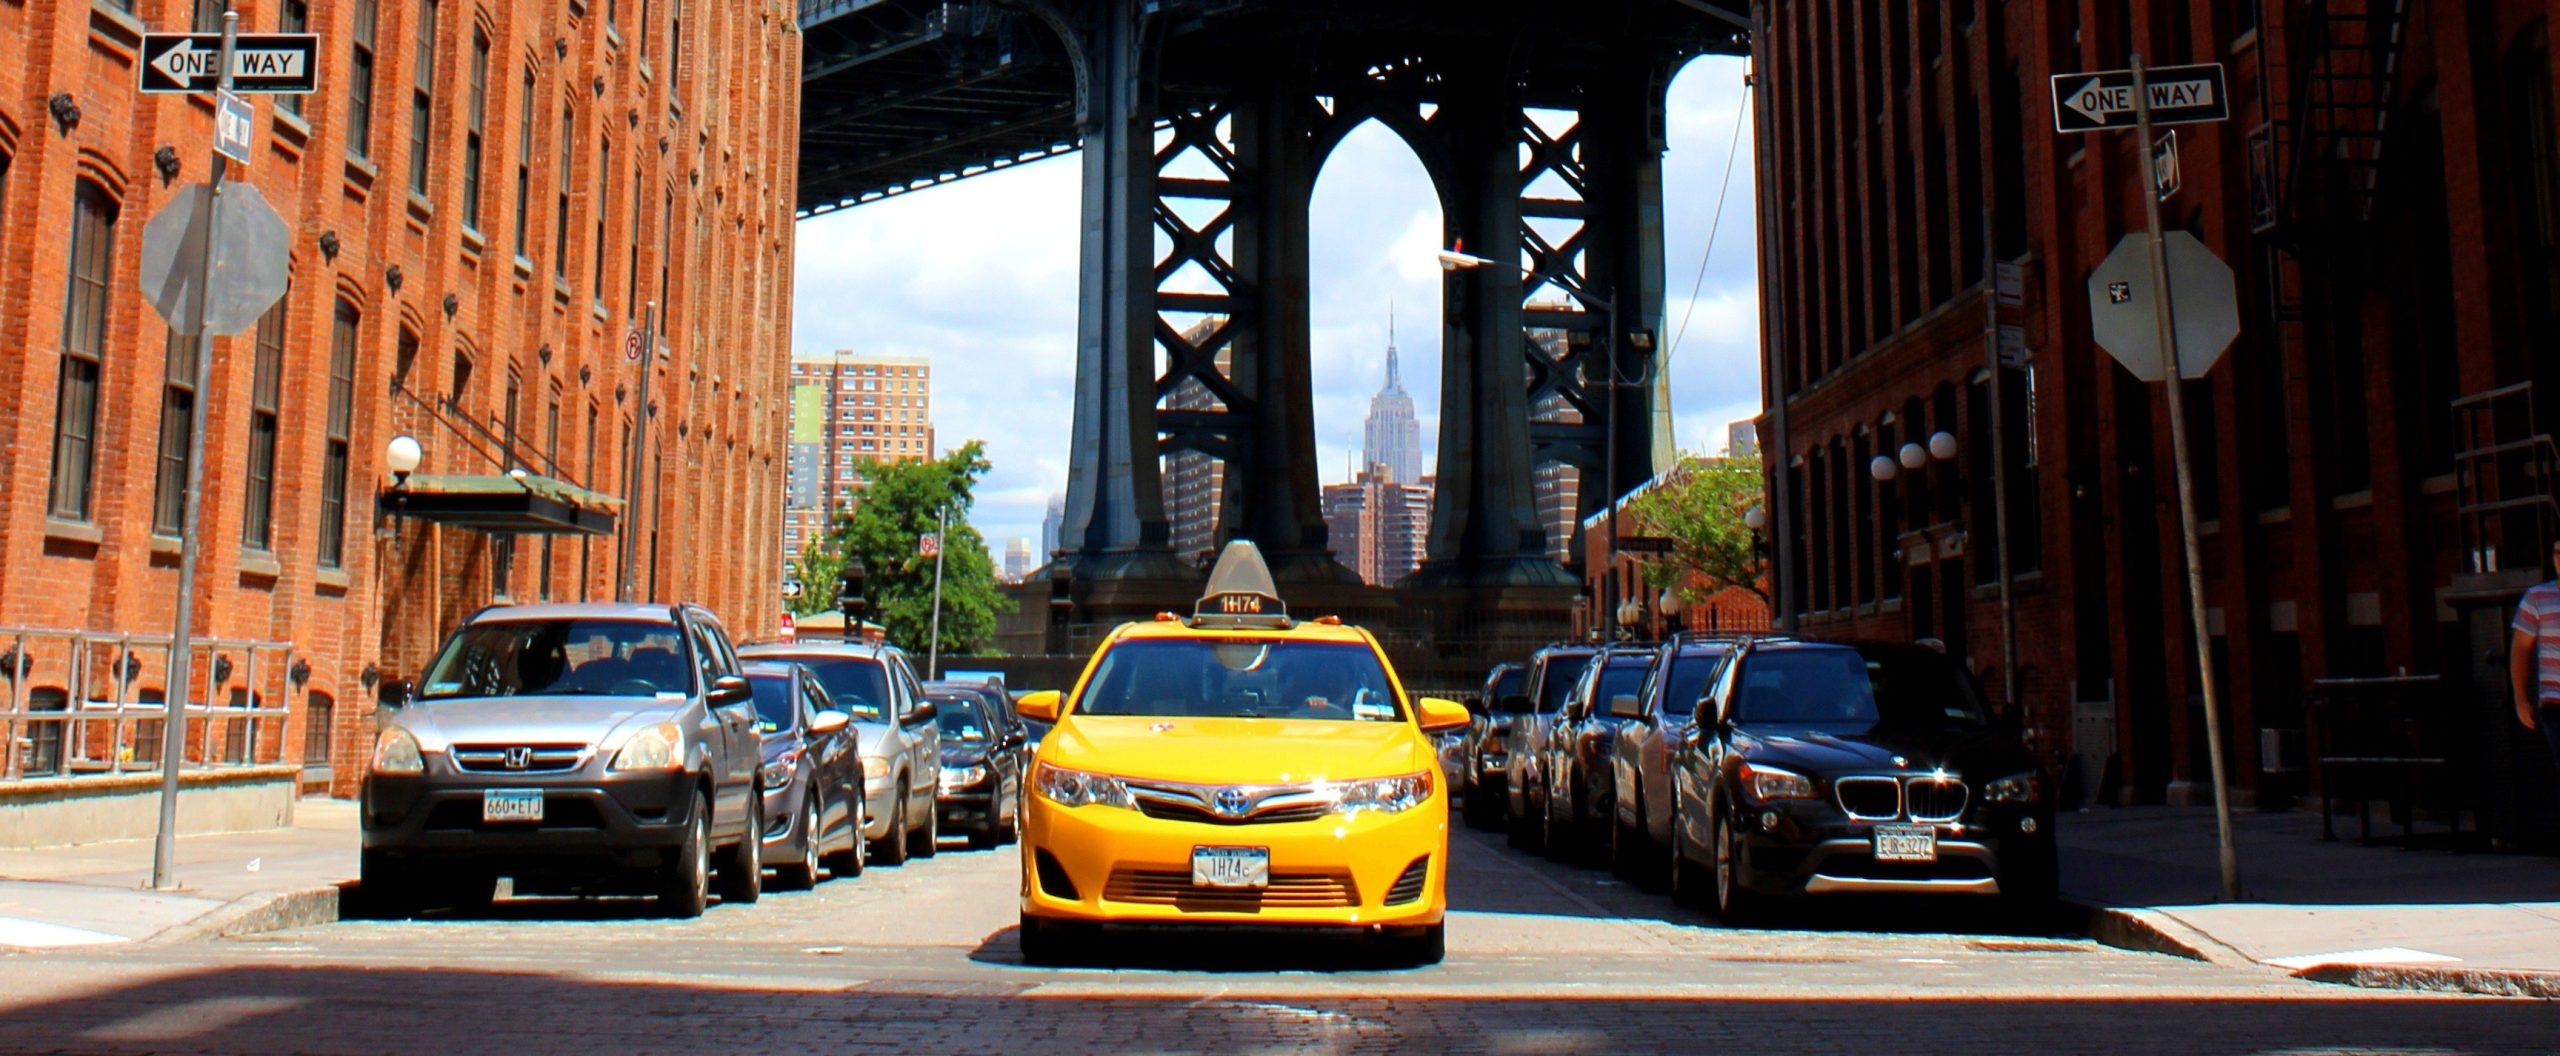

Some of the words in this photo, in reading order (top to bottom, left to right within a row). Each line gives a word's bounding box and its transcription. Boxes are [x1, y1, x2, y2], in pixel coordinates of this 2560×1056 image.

[170, 53, 217, 74] ONE
[242, 53, 293, 74] WAY
[2082, 88, 2130, 112] ONE
[2151, 83, 2200, 107] WAY
[798, 445, 809, 504] Mellon
[1221, 595, 1260, 613] 1H74
